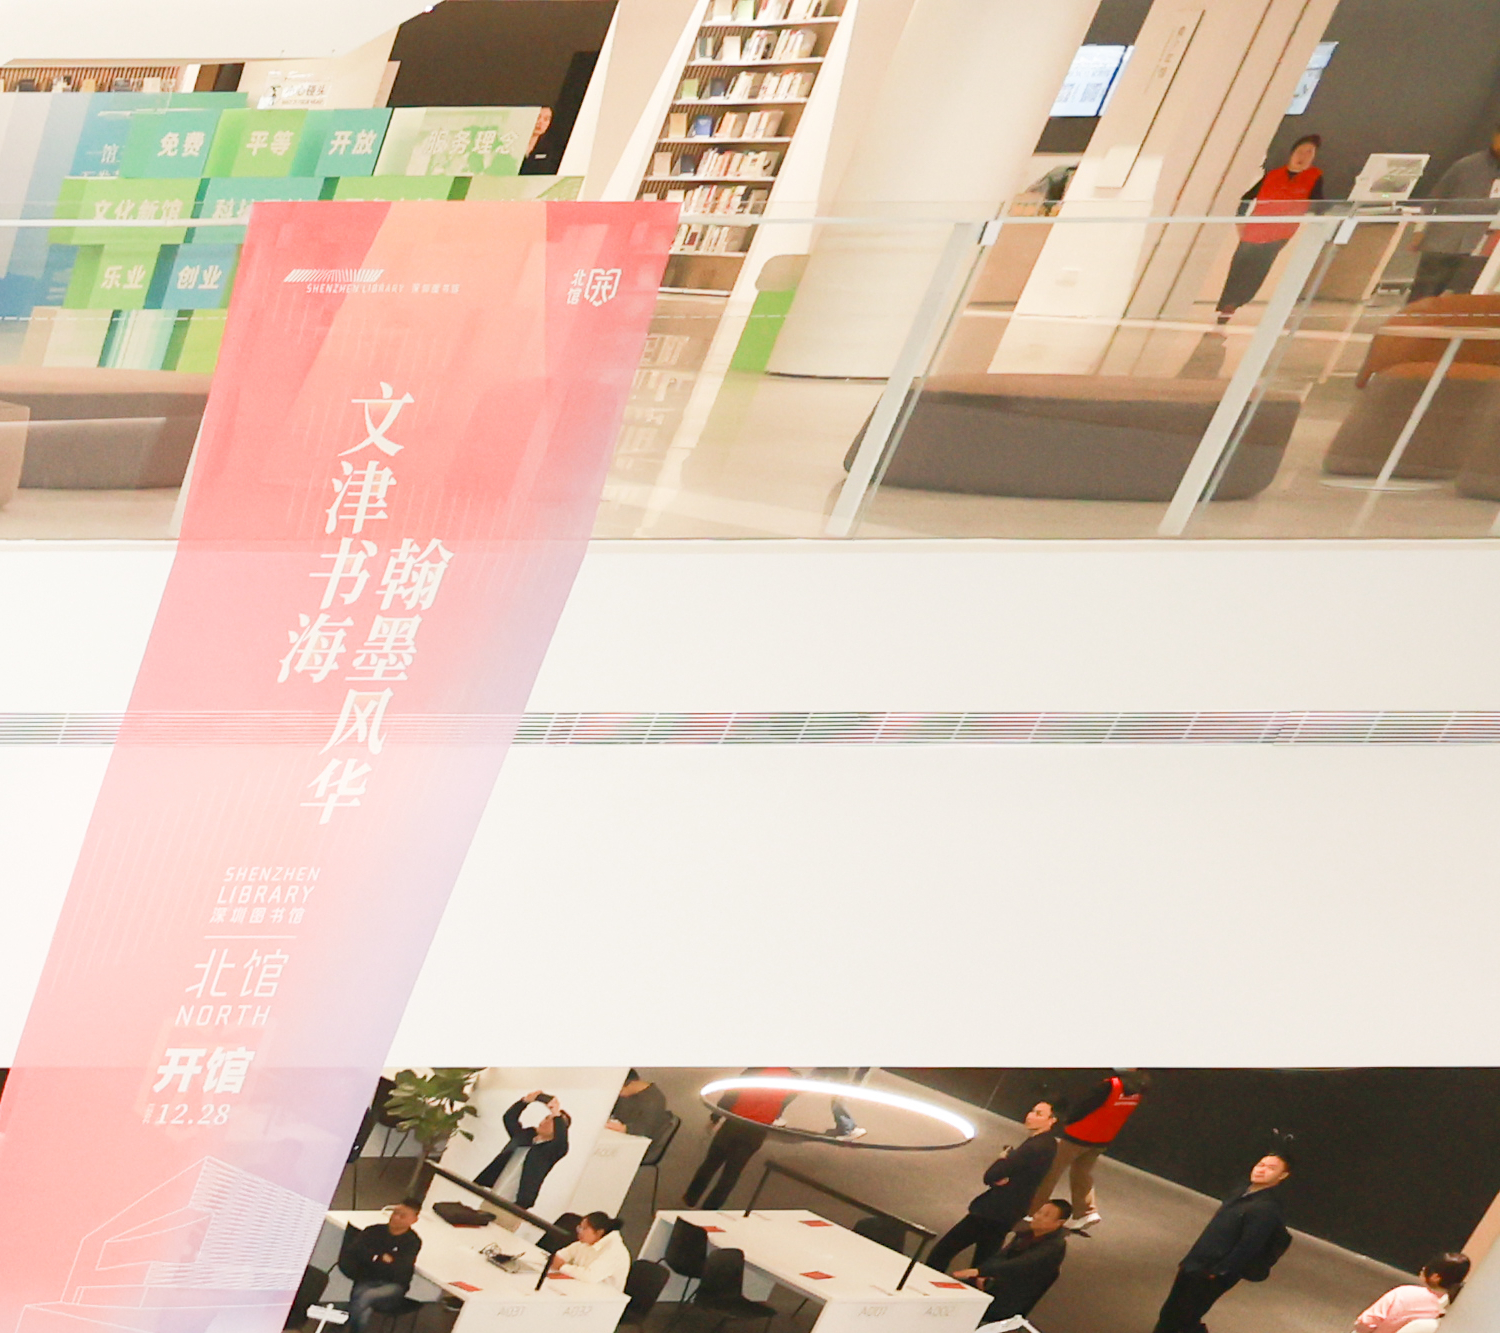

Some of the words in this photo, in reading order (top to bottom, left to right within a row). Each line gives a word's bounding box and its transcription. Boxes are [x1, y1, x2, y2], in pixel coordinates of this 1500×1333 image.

[156, 130, 206, 158] 免费
[245, 129, 295, 157] 平等
[327, 129, 378, 156] 开放
[421, 129, 520, 156] 服务理念
[100, 264, 147, 290] 乐业
[176, 264, 223, 290] 创业
[566, 268, 586, 305] 北馆
[276, 380, 417, 685] 文津书海
[299, 535, 455, 826] 翰墨风华
[222, 866, 322, 883] SHENZHEN
[216, 885, 316, 905] LIBRARY
[208, 906, 306, 925] 深圳图书馆
[184, 947, 291, 1000] 北馆
[173, 1004, 272, 1027] NORTH
[152, 1045, 257, 1096] 开馆
[154, 1103, 232, 1127] 12.28
